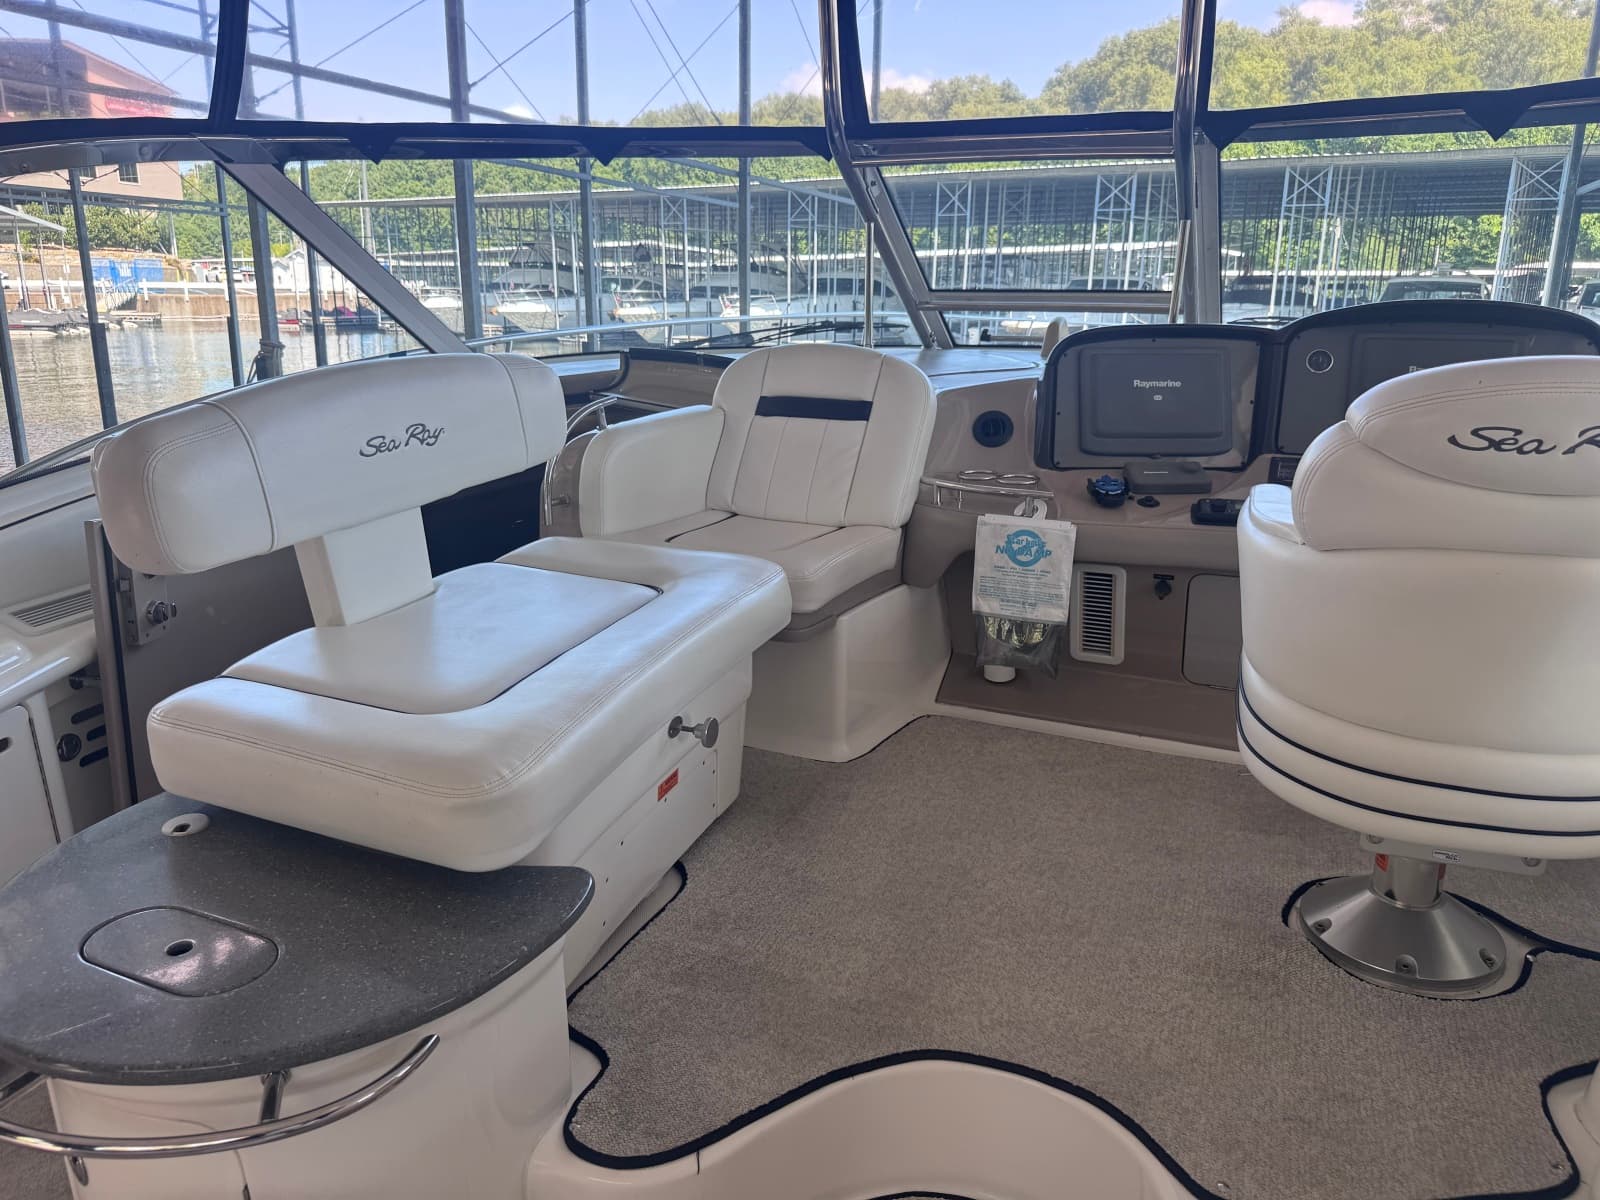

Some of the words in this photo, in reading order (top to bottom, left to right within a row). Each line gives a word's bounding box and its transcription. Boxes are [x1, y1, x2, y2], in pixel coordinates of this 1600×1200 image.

[1133, 379, 1182, 389] Raymarine
[359, 435, 401, 457] Sea
[405, 423, 444, 447] Ray
[1447, 426, 1557, 455] Sea
